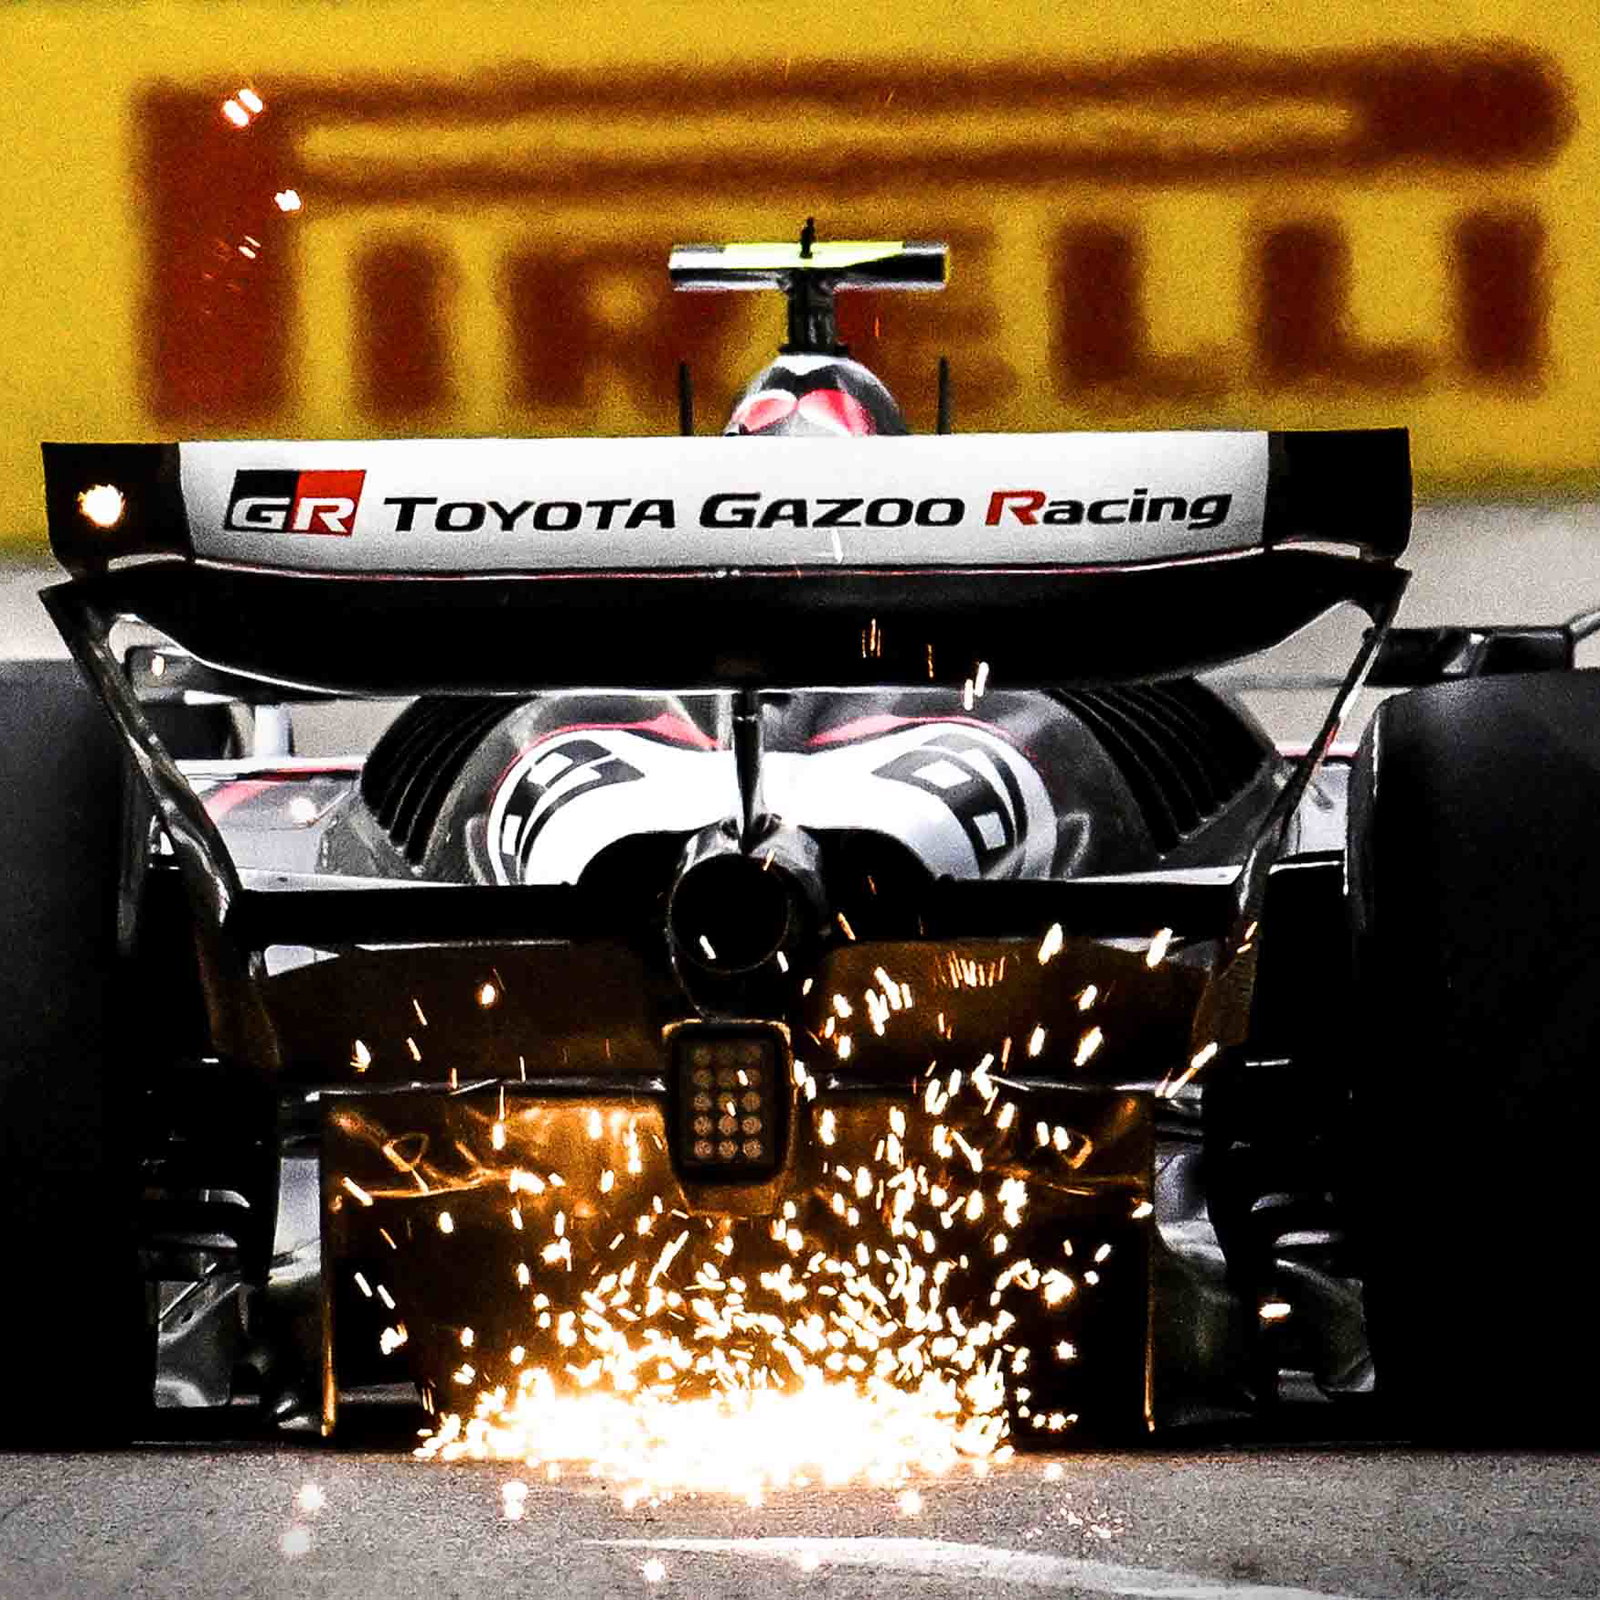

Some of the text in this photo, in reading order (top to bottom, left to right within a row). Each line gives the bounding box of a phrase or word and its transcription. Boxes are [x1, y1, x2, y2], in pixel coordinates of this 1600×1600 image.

[230, 497, 358, 533] GR
[385, 488, 1233, 532] TOYOTA GAZOO Racing
